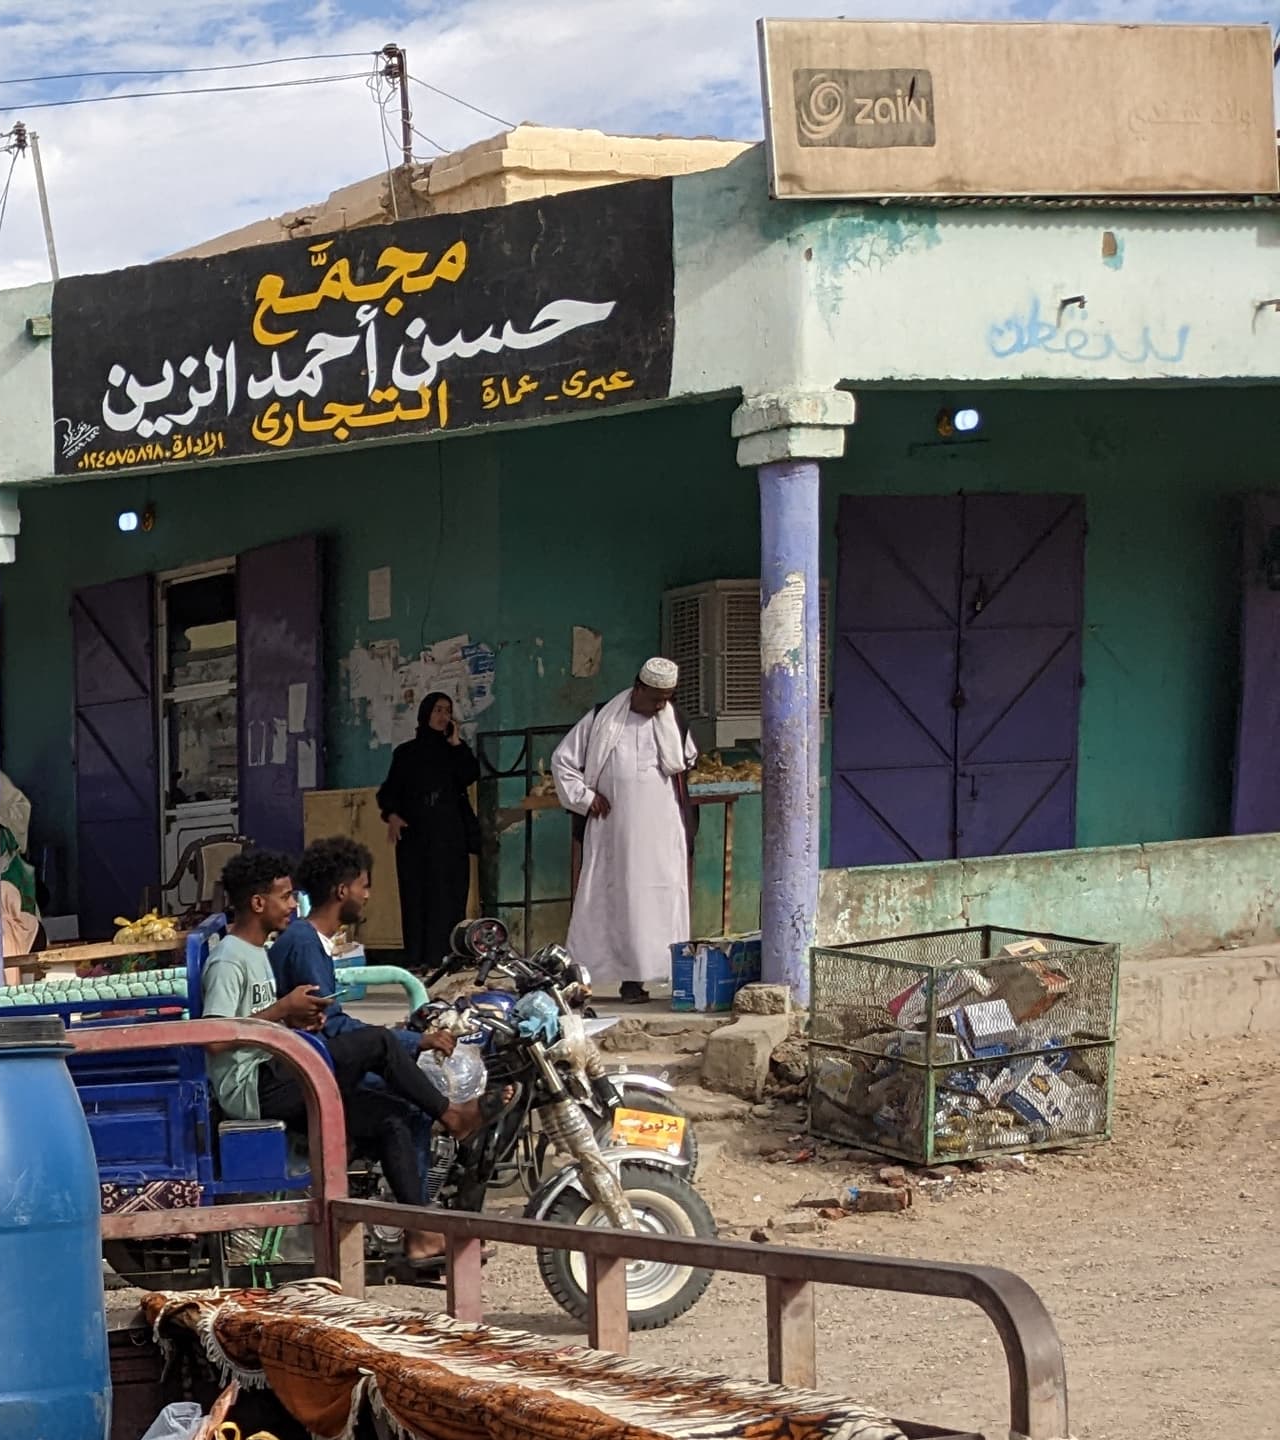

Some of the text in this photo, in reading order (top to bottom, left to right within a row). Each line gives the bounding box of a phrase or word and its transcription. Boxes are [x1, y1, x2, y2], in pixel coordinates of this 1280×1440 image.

[852, 88, 928, 126] zain
[102, 340, 239, 439] الزين
[246, 305, 379, 401] أحمد
[391, 299, 617, 393] حسن
